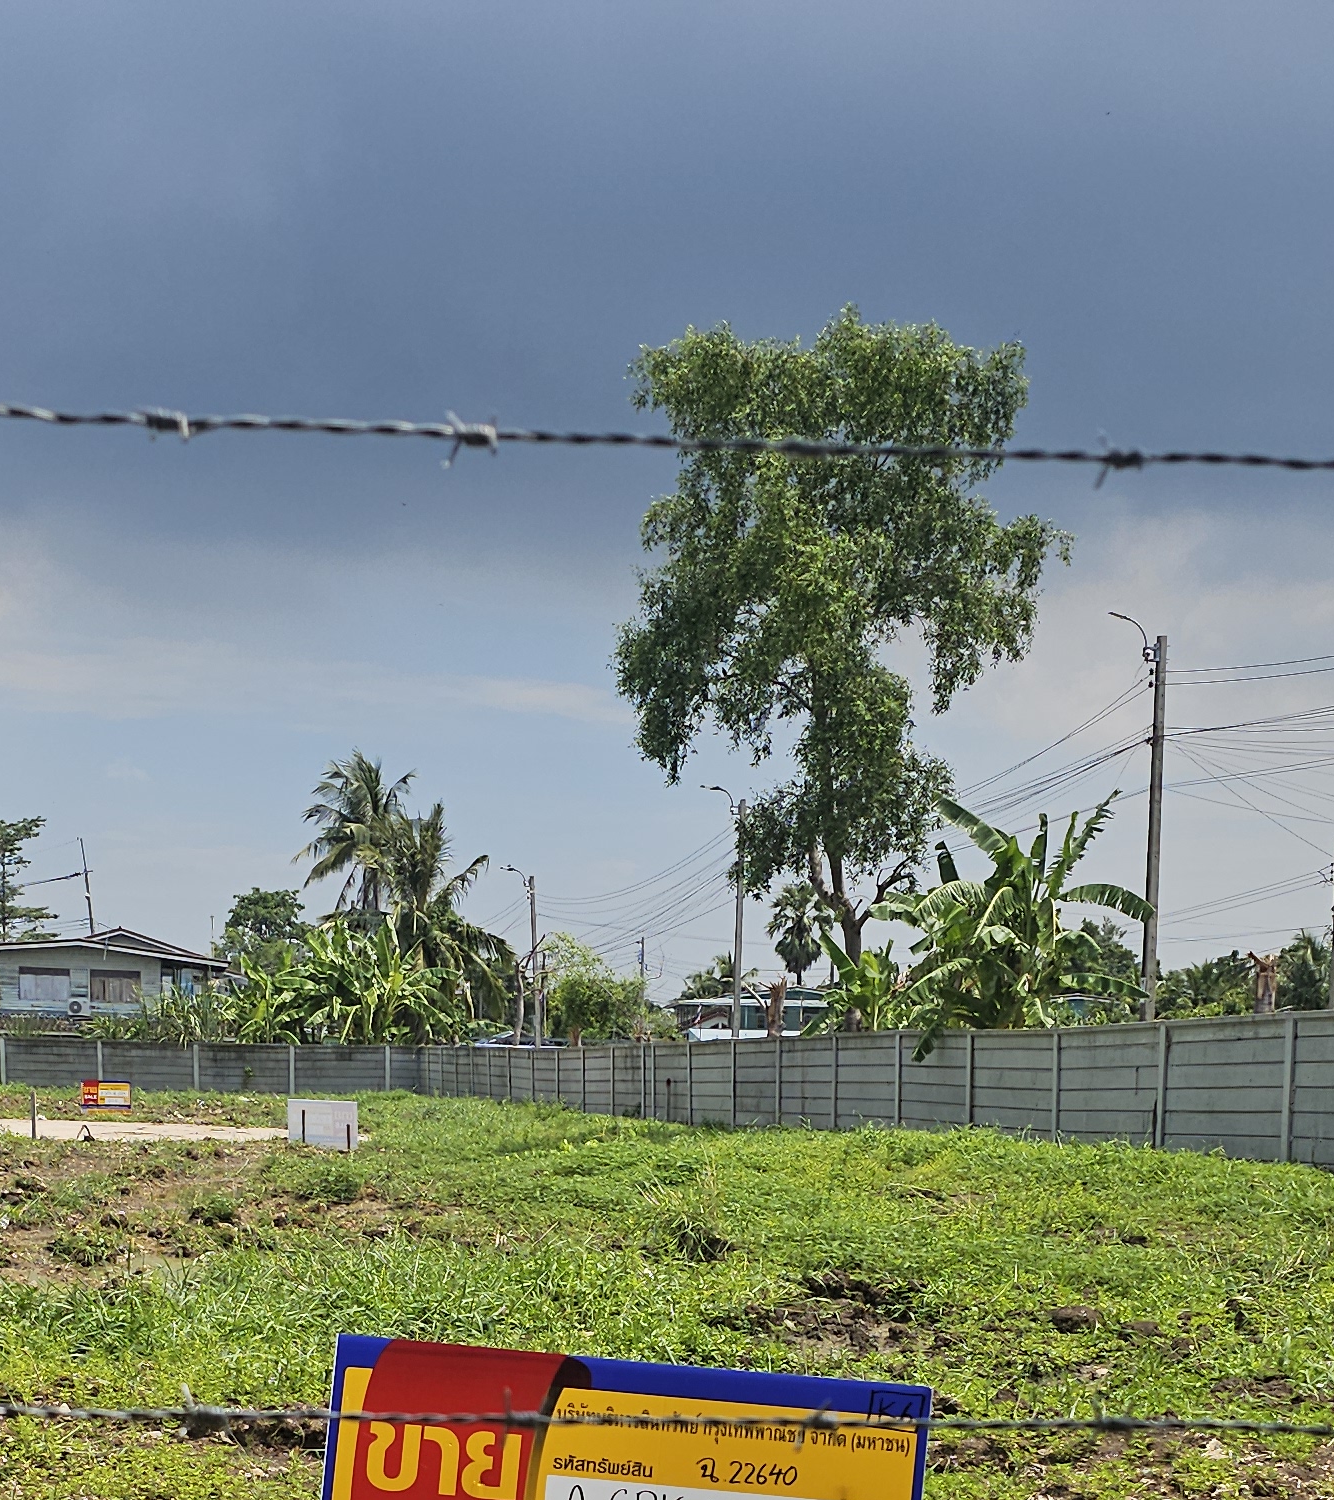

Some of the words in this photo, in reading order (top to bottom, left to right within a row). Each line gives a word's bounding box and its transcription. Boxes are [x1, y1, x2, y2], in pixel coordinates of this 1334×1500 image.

[851, 1432, 911, 1457] (มหาชน)
[552, 1454, 654, 1479] รหัสทรัพย์สิน
